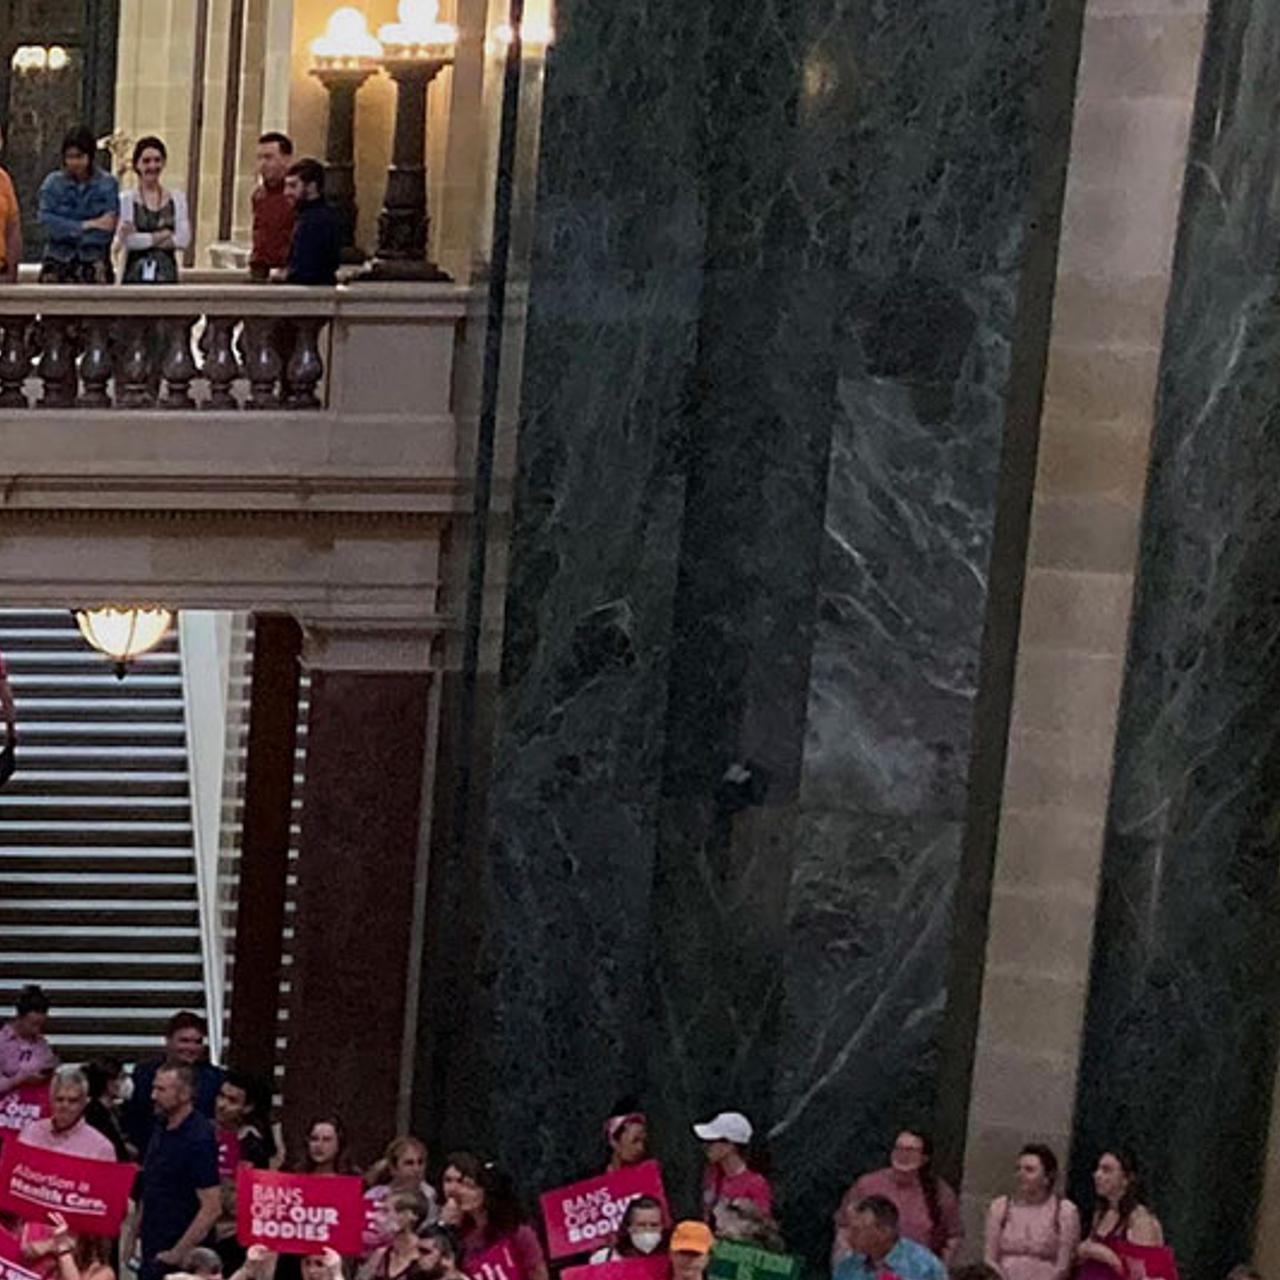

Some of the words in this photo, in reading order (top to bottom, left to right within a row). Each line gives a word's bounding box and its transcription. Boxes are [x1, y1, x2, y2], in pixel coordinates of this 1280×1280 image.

[11, 1163, 76, 1190] Abortion
[77, 1174, 90, 1192] is
[10, 1176, 63, 1204] Health
[252, 1184, 304, 1206] BANS
[562, 1187, 612, 1210] BANS
[251, 1202, 290, 1221] OFF
[289, 1206, 340, 1226] OUR
[564, 1206, 601, 1231] OFF
[251, 1218, 330, 1242] BODIES
